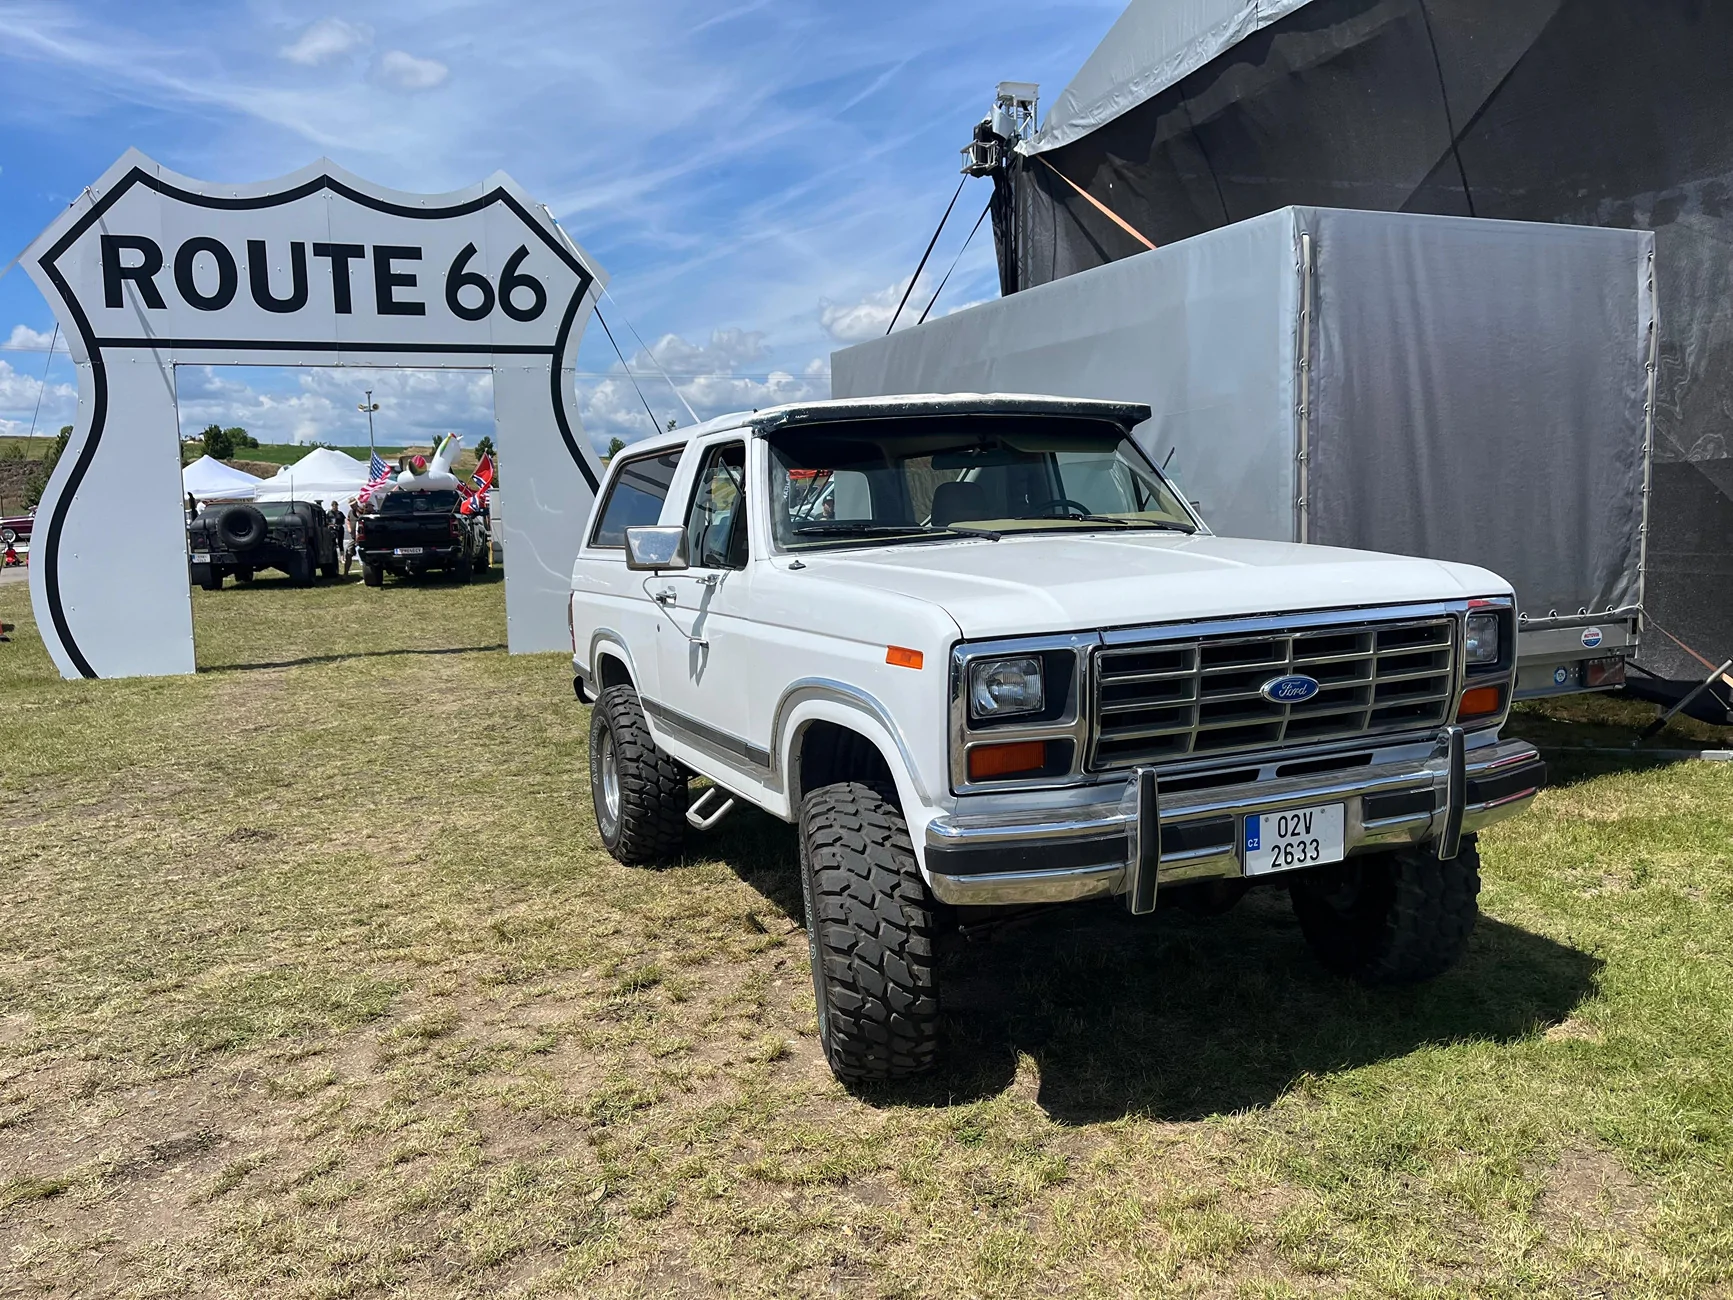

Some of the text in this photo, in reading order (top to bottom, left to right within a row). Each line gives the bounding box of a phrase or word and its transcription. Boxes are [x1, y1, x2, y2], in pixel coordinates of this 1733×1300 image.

[100, 234, 548, 322] ROUTE 66
[1279, 681, 1308, 697] Ford
[1277, 811, 1313, 838] 02V
[1247, 838, 1259, 848] CZ
[1271, 838, 1320, 868] 2633
